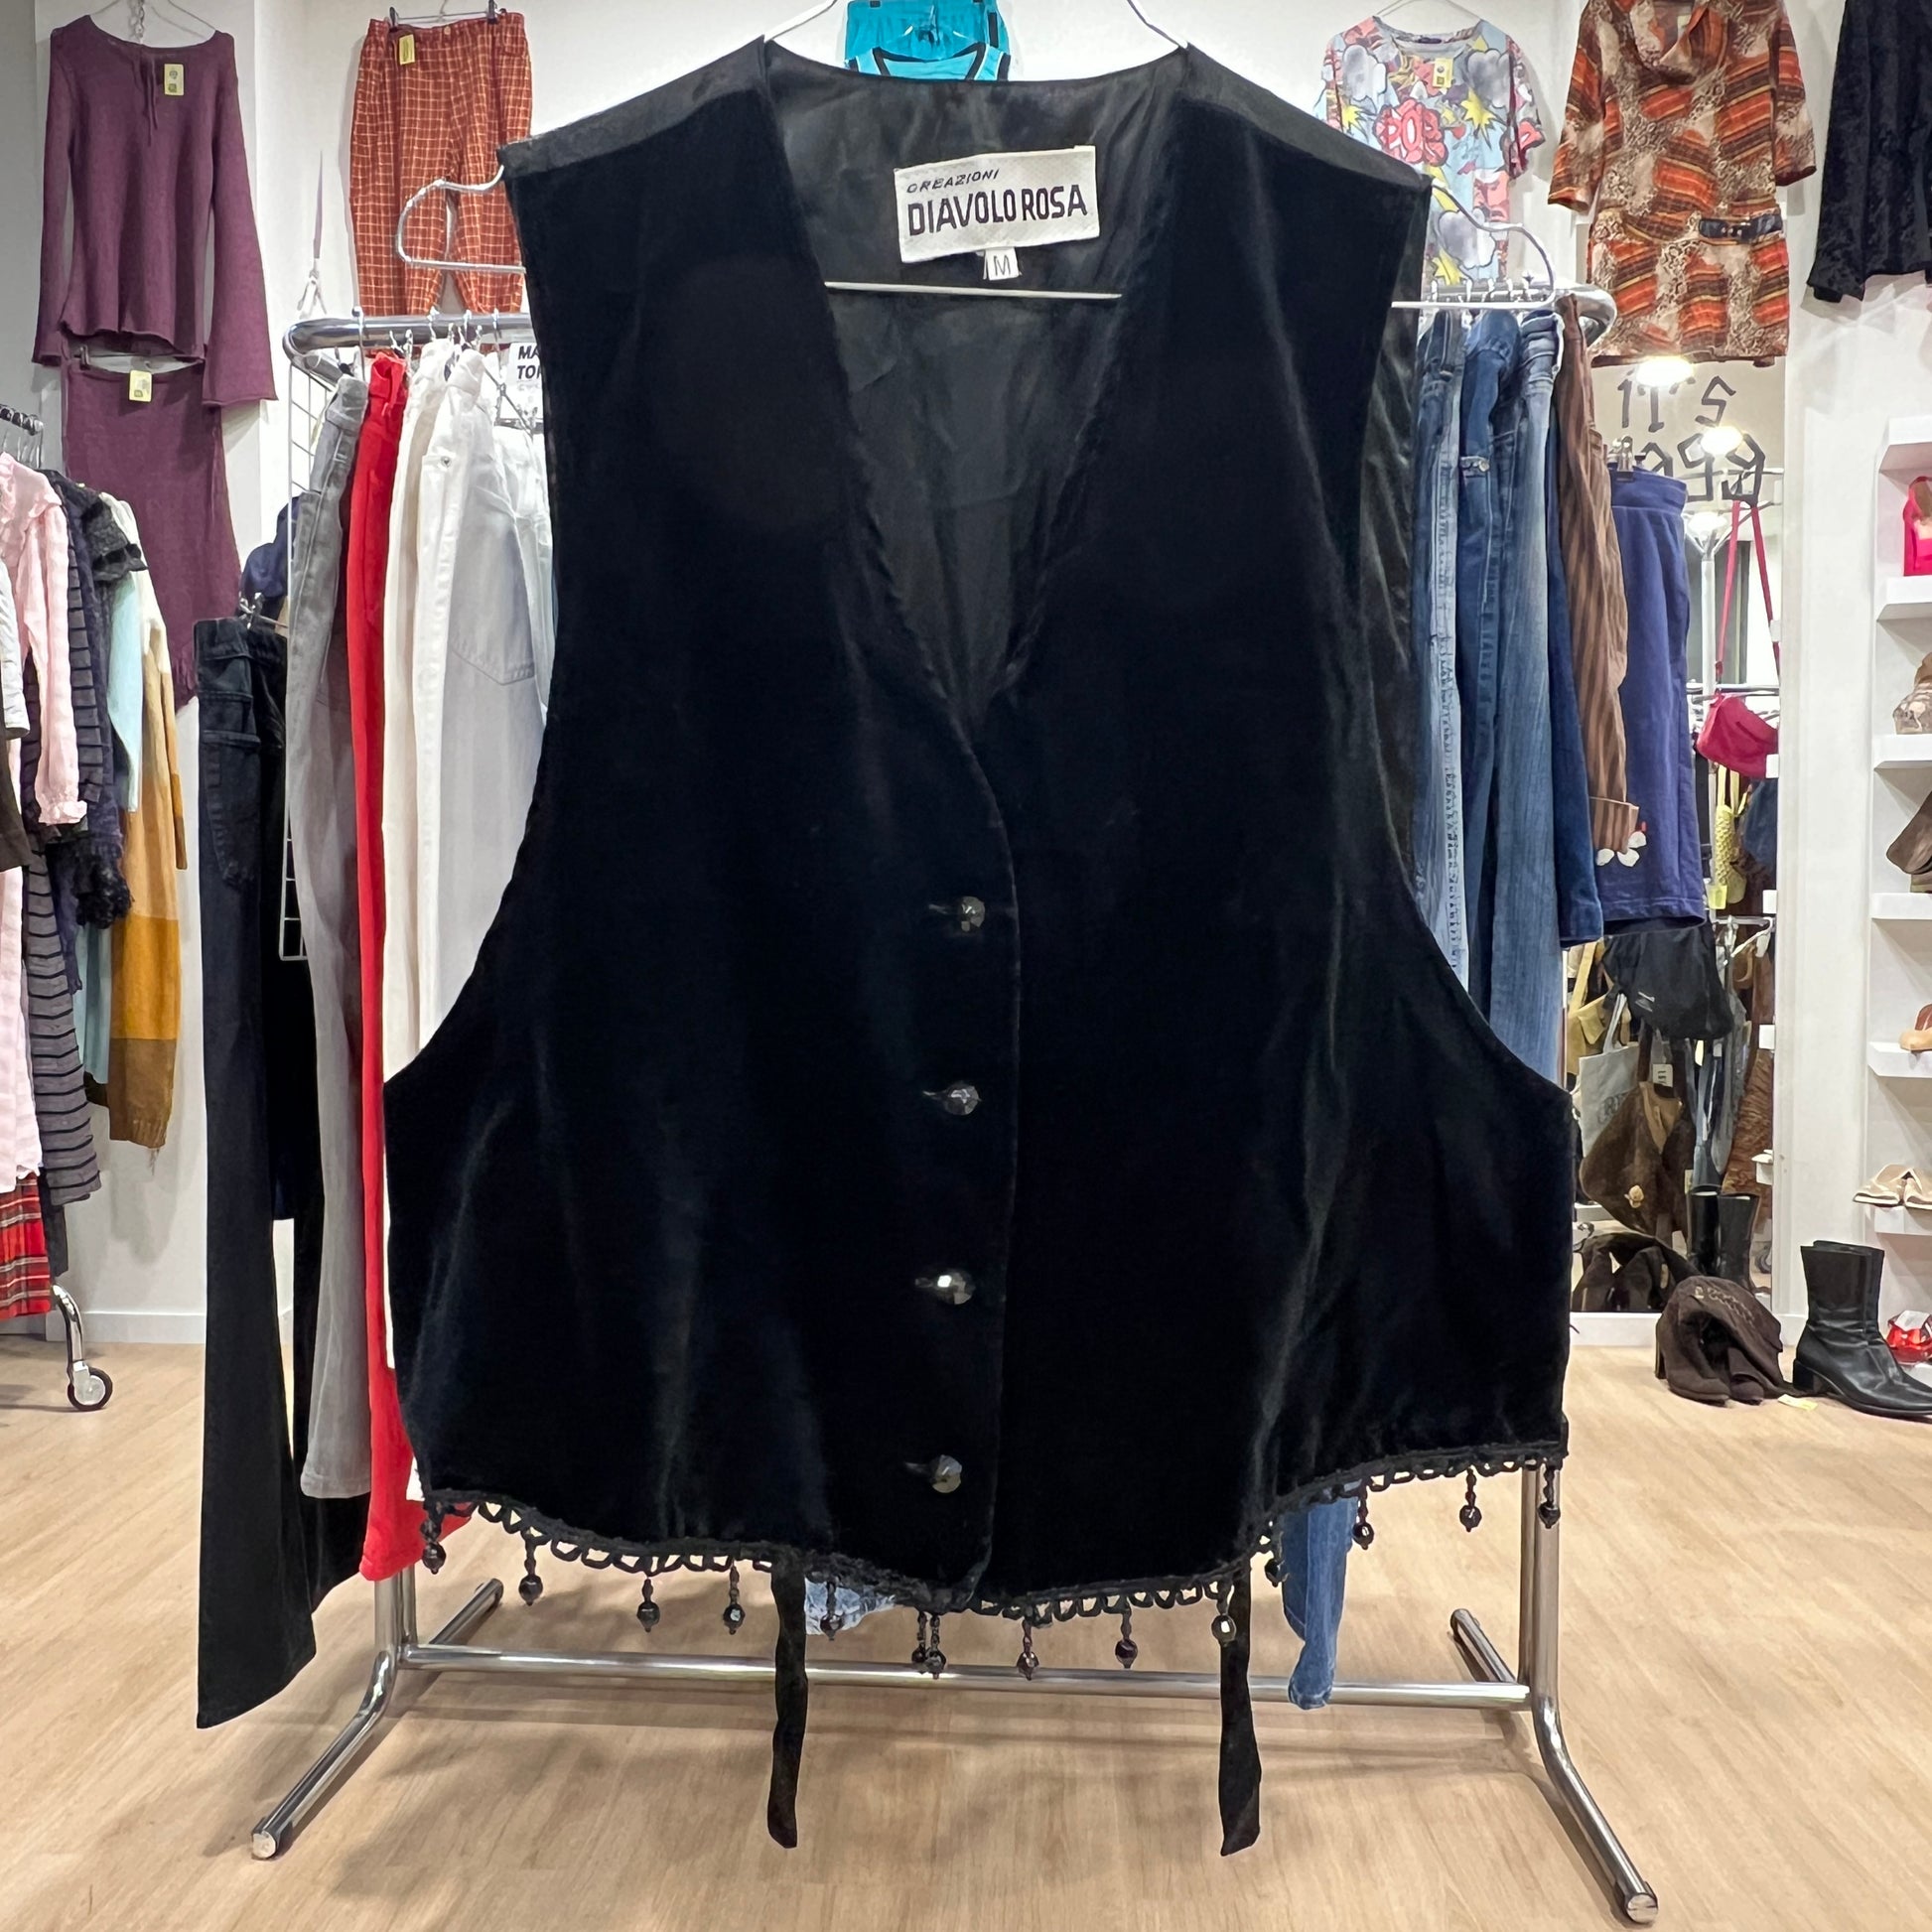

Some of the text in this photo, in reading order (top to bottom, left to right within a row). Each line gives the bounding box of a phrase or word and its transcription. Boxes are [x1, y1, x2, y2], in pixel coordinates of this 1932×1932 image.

[906, 168, 1000, 194] CREAZIONI
[994, 255, 1012, 276] M
[517, 365, 541, 379] TO
